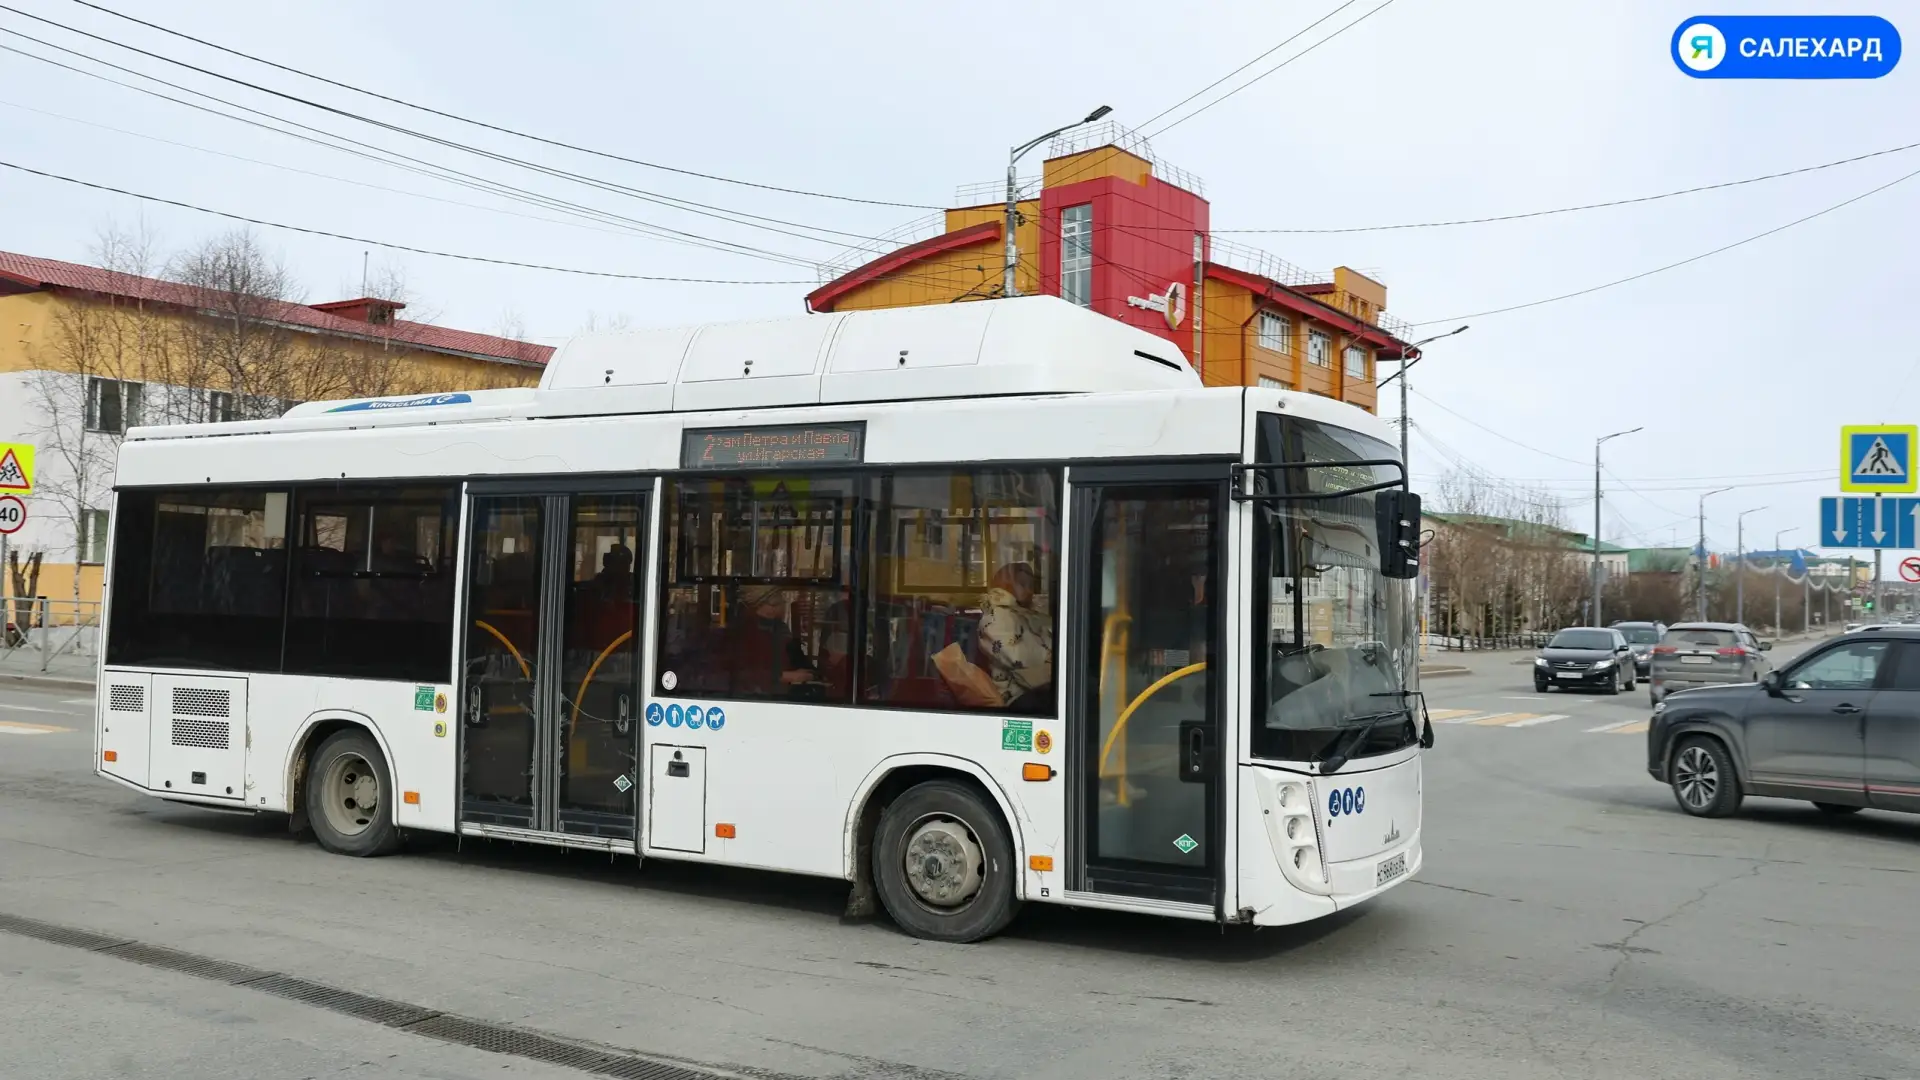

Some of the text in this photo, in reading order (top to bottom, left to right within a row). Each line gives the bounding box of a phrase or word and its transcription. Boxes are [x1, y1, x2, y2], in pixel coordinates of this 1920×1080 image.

[743, 432, 788, 446] Петра
[804, 430, 849, 445] Павла
[703, 434, 714, 461] 2
[0, 507, 19, 523] 40
